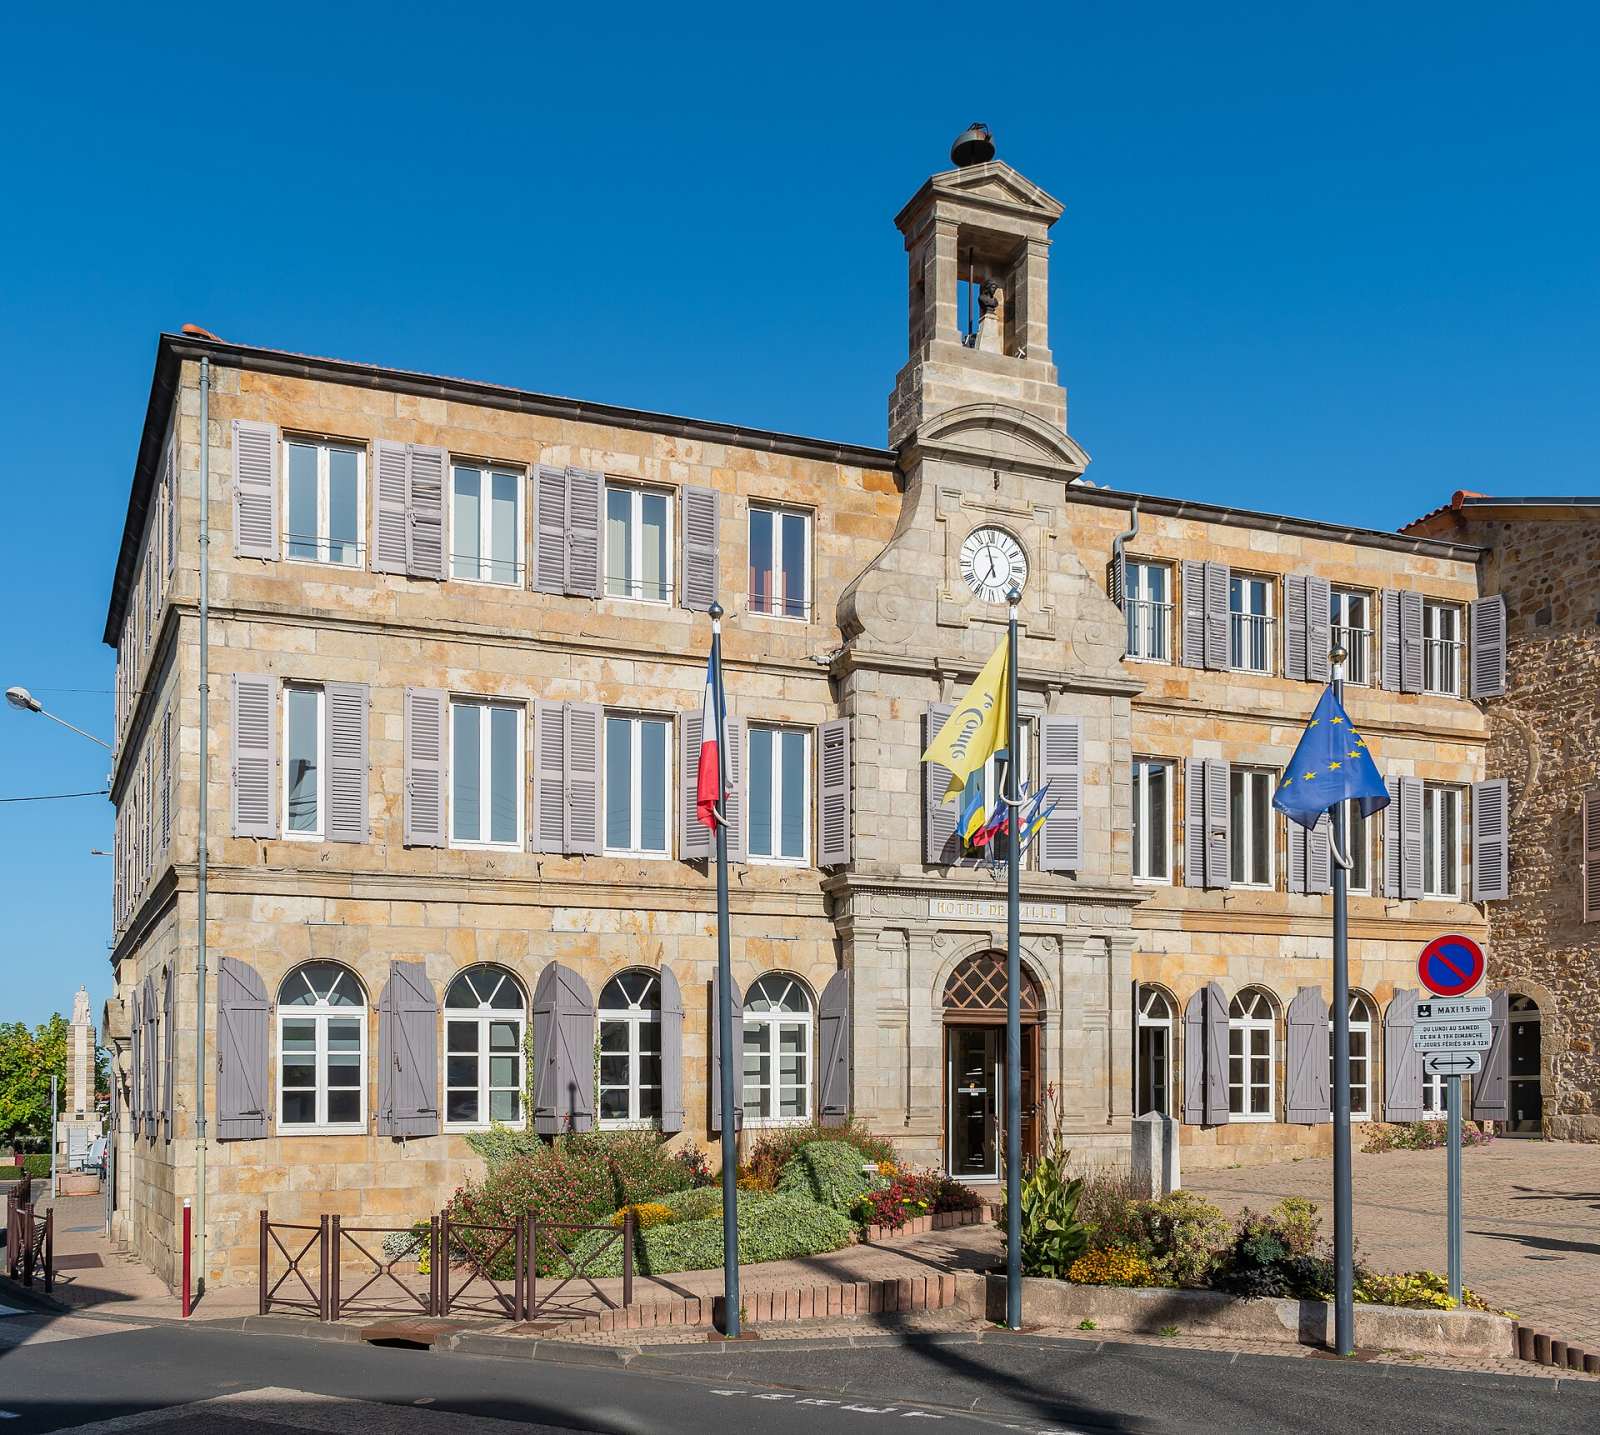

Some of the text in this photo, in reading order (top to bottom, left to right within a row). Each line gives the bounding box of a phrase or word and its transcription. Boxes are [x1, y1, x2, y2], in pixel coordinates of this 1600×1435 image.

[989, 905, 1005, 917] DE
[1437, 1006, 1459, 1014] MAXI
[1461, 1005, 1471, 1013] 15
